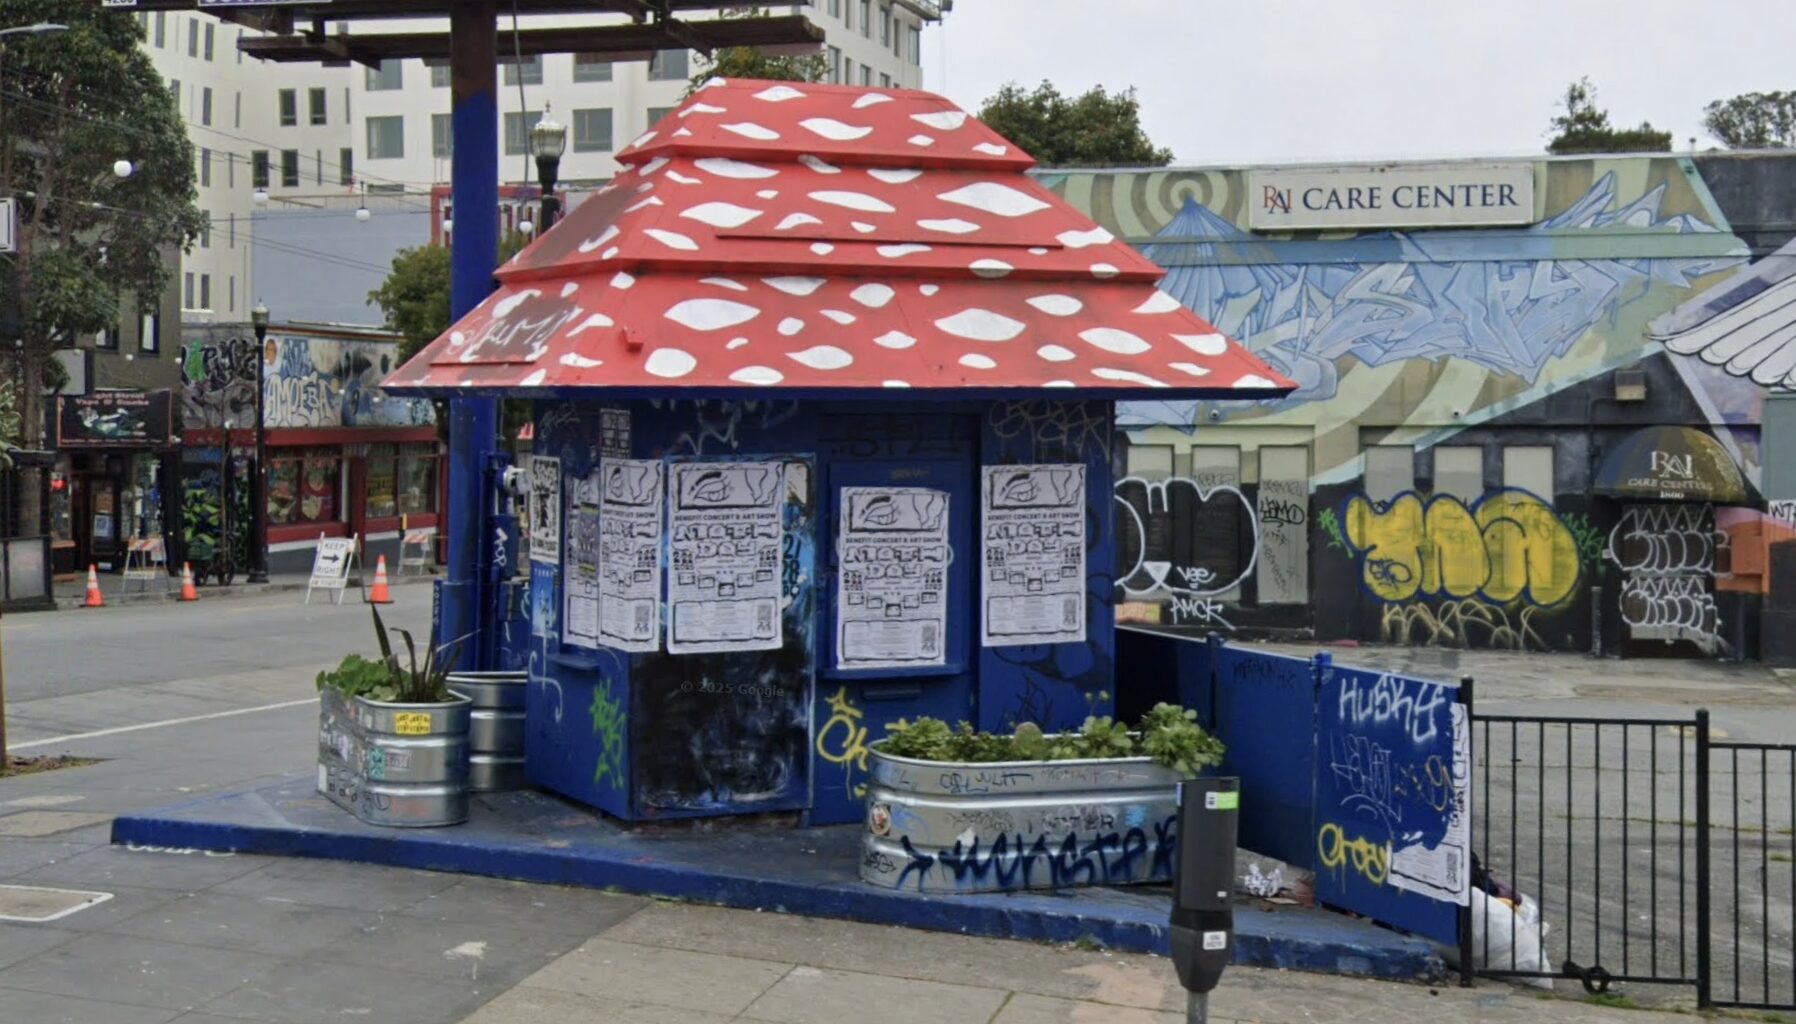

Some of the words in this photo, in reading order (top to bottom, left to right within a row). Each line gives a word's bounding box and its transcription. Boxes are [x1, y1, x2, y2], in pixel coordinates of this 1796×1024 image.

[1302, 186, 1382, 211] CARE
[1391, 183, 1520, 209] CENTER
[1627, 478, 1658, 487] CARE
